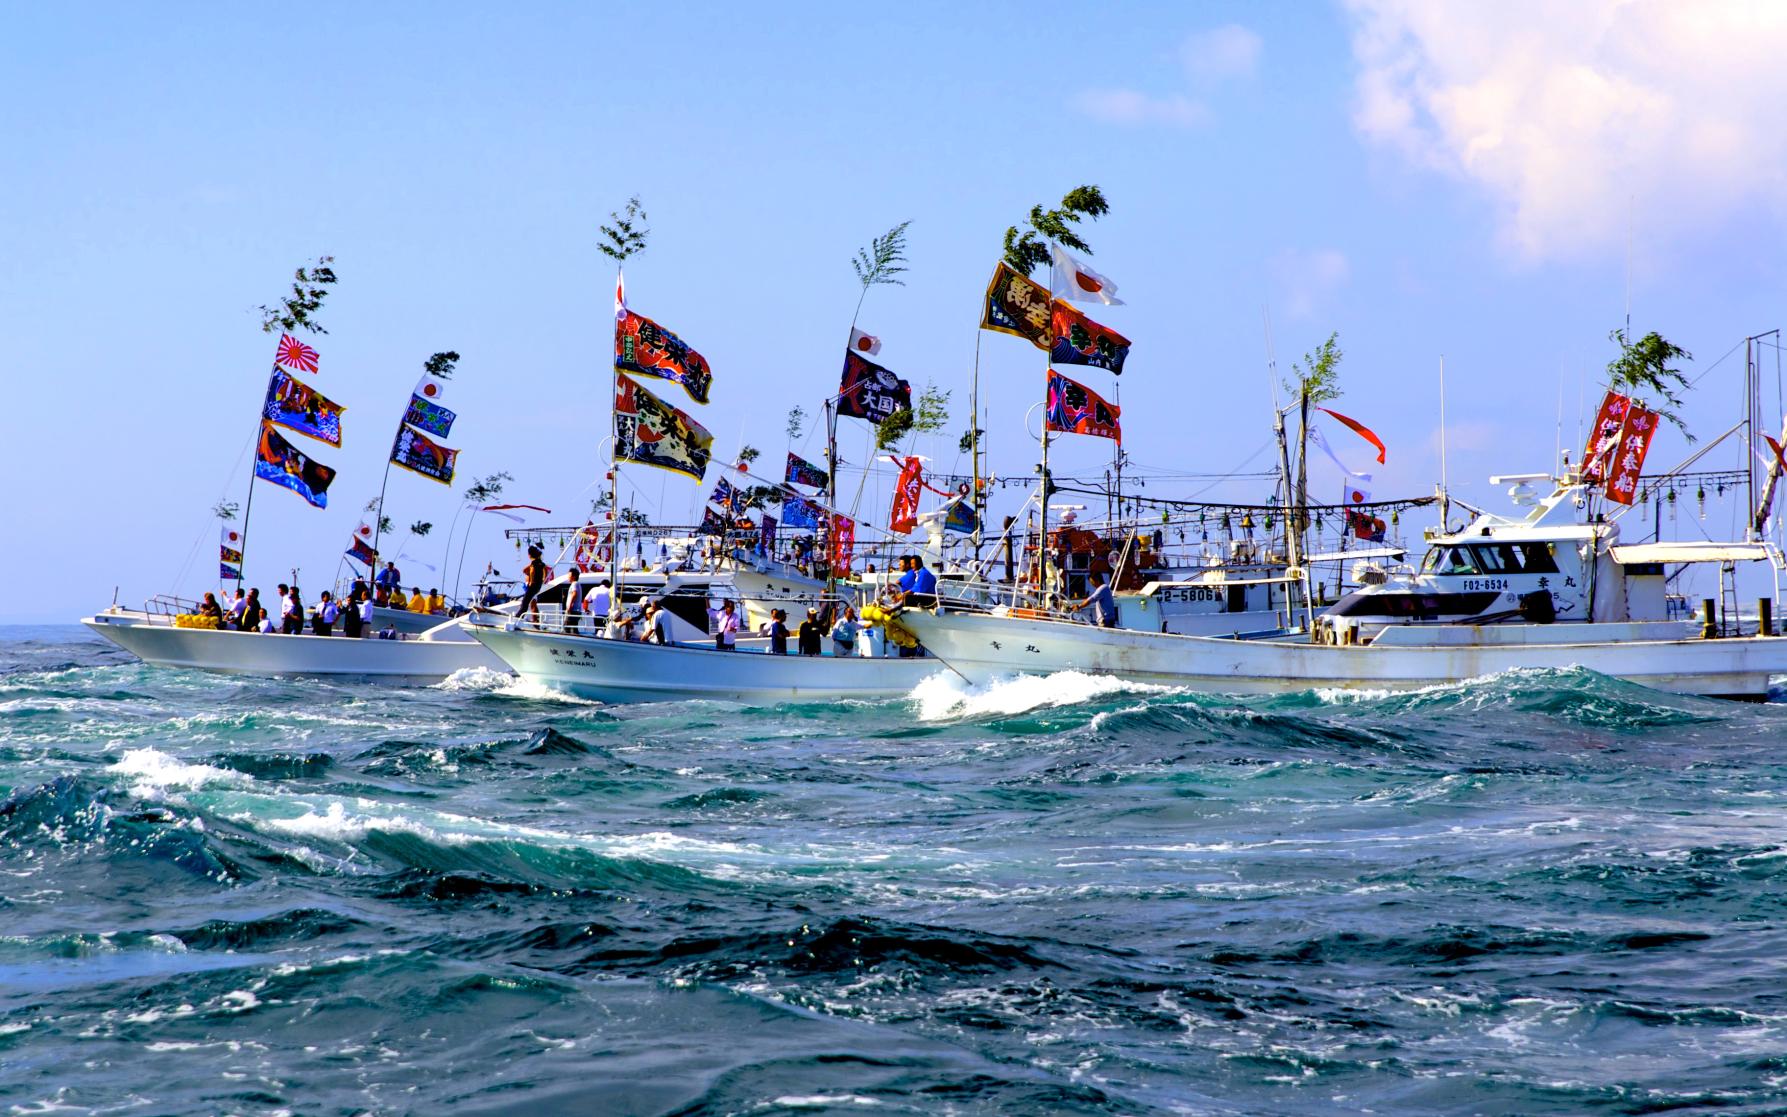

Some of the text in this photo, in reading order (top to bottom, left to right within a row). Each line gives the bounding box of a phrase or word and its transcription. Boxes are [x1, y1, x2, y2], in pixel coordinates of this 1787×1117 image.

[1613, 433, 1644, 493] 供奉船
[1537, 576, 1577, 588] 幸丸
